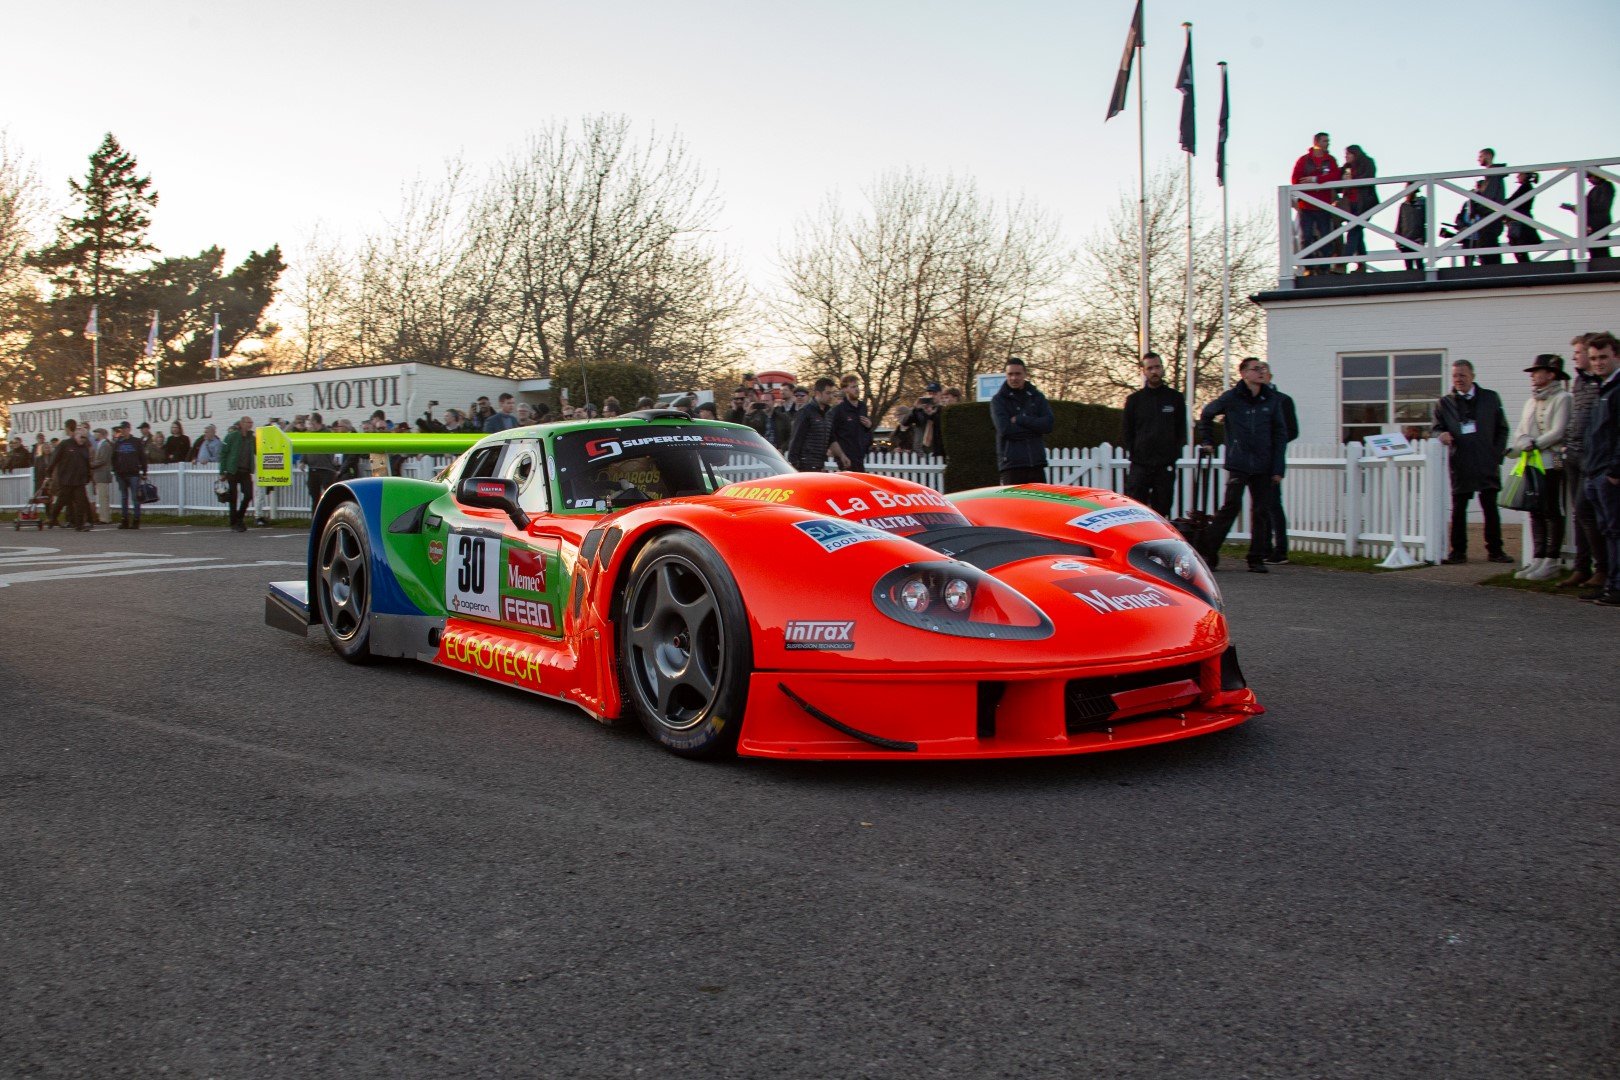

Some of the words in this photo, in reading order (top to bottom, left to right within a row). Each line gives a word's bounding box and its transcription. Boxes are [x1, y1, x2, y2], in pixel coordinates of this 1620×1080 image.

[143, 394, 212, 424] MOTUL
[228, 397, 267, 411] MOTOR
[269, 393, 294, 408] OILS
[12, 408, 64, 434] MOTUL
[622, 435, 703, 448] SUPERCAR
[724, 487, 795, 503] MARCOS
[826, 497, 870, 516] La
[825, 536, 858, 551] FOOD
[458, 535, 486, 594] 30
[508, 564, 541, 592] Memec
[1072, 589, 1170, 615] Memec
[445, 632, 542, 684] EUROTECH
